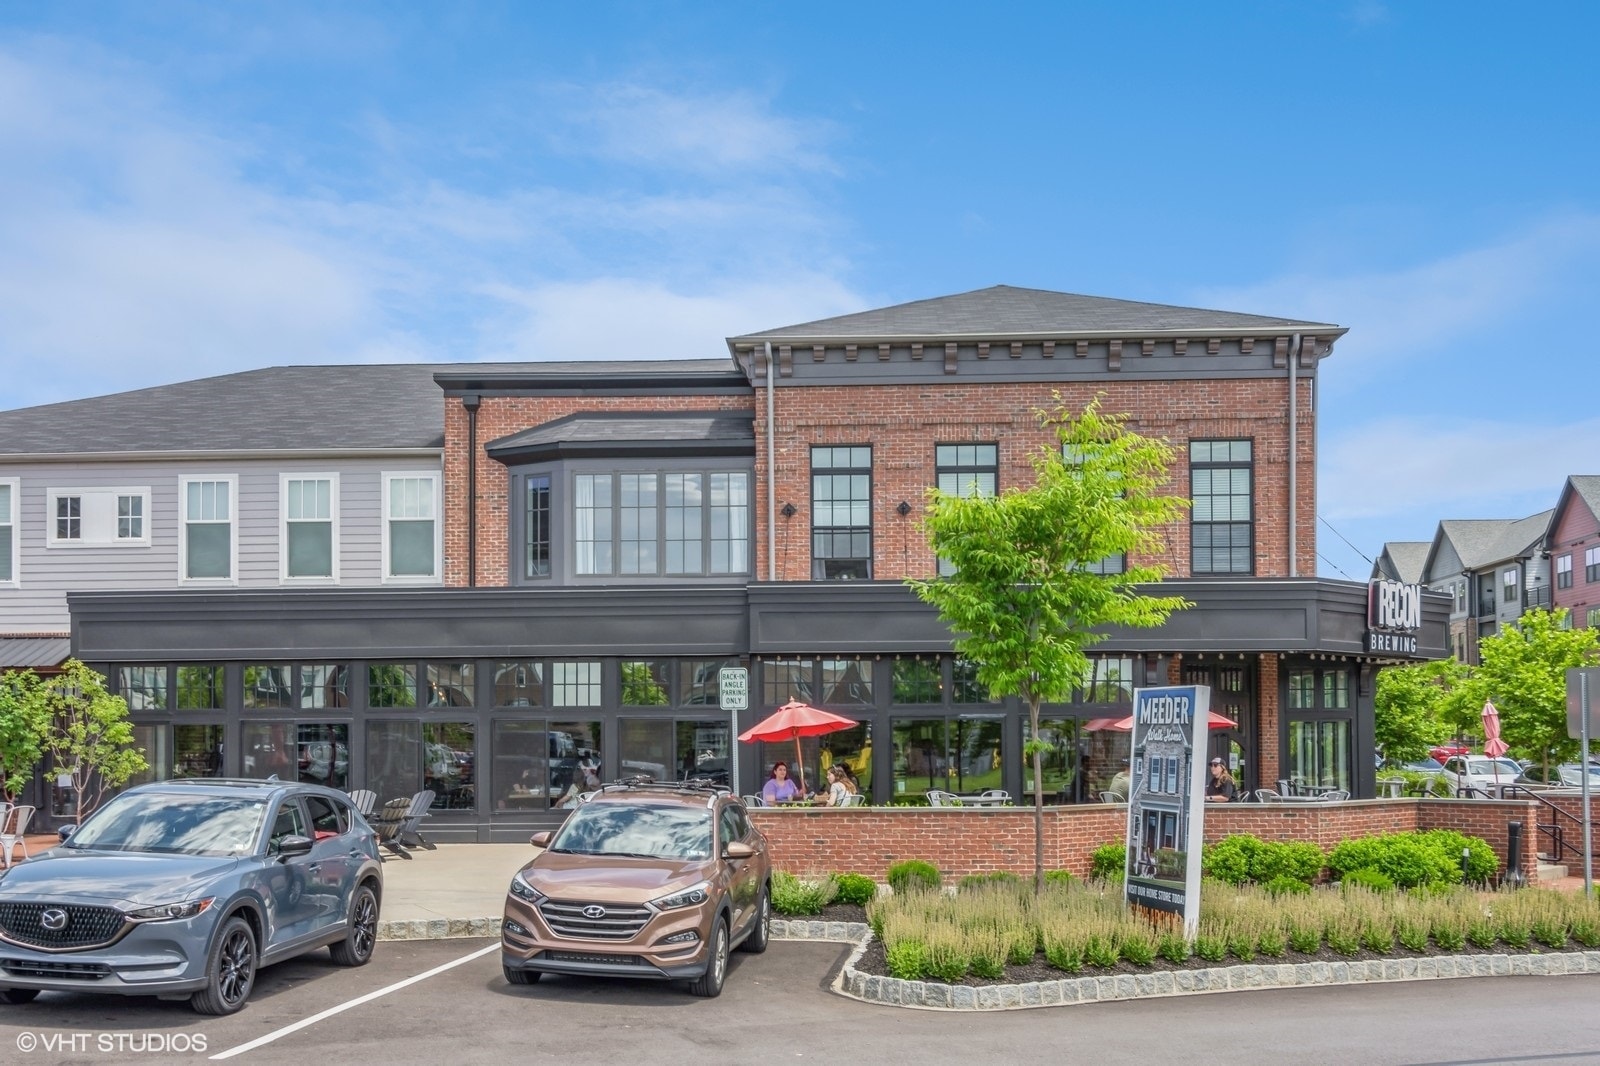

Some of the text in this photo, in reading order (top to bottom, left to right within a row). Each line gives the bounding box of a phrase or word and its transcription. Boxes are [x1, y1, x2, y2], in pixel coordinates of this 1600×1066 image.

[1379, 580, 1420, 629] RECON
[1371, 633, 1417, 653] BREWING
[1140, 695, 1189, 724] MEEDER
[1138, 886, 1146, 896] OUR
[1146, 888, 1158, 899] HOME
[1158, 890, 1171, 902] STORE
